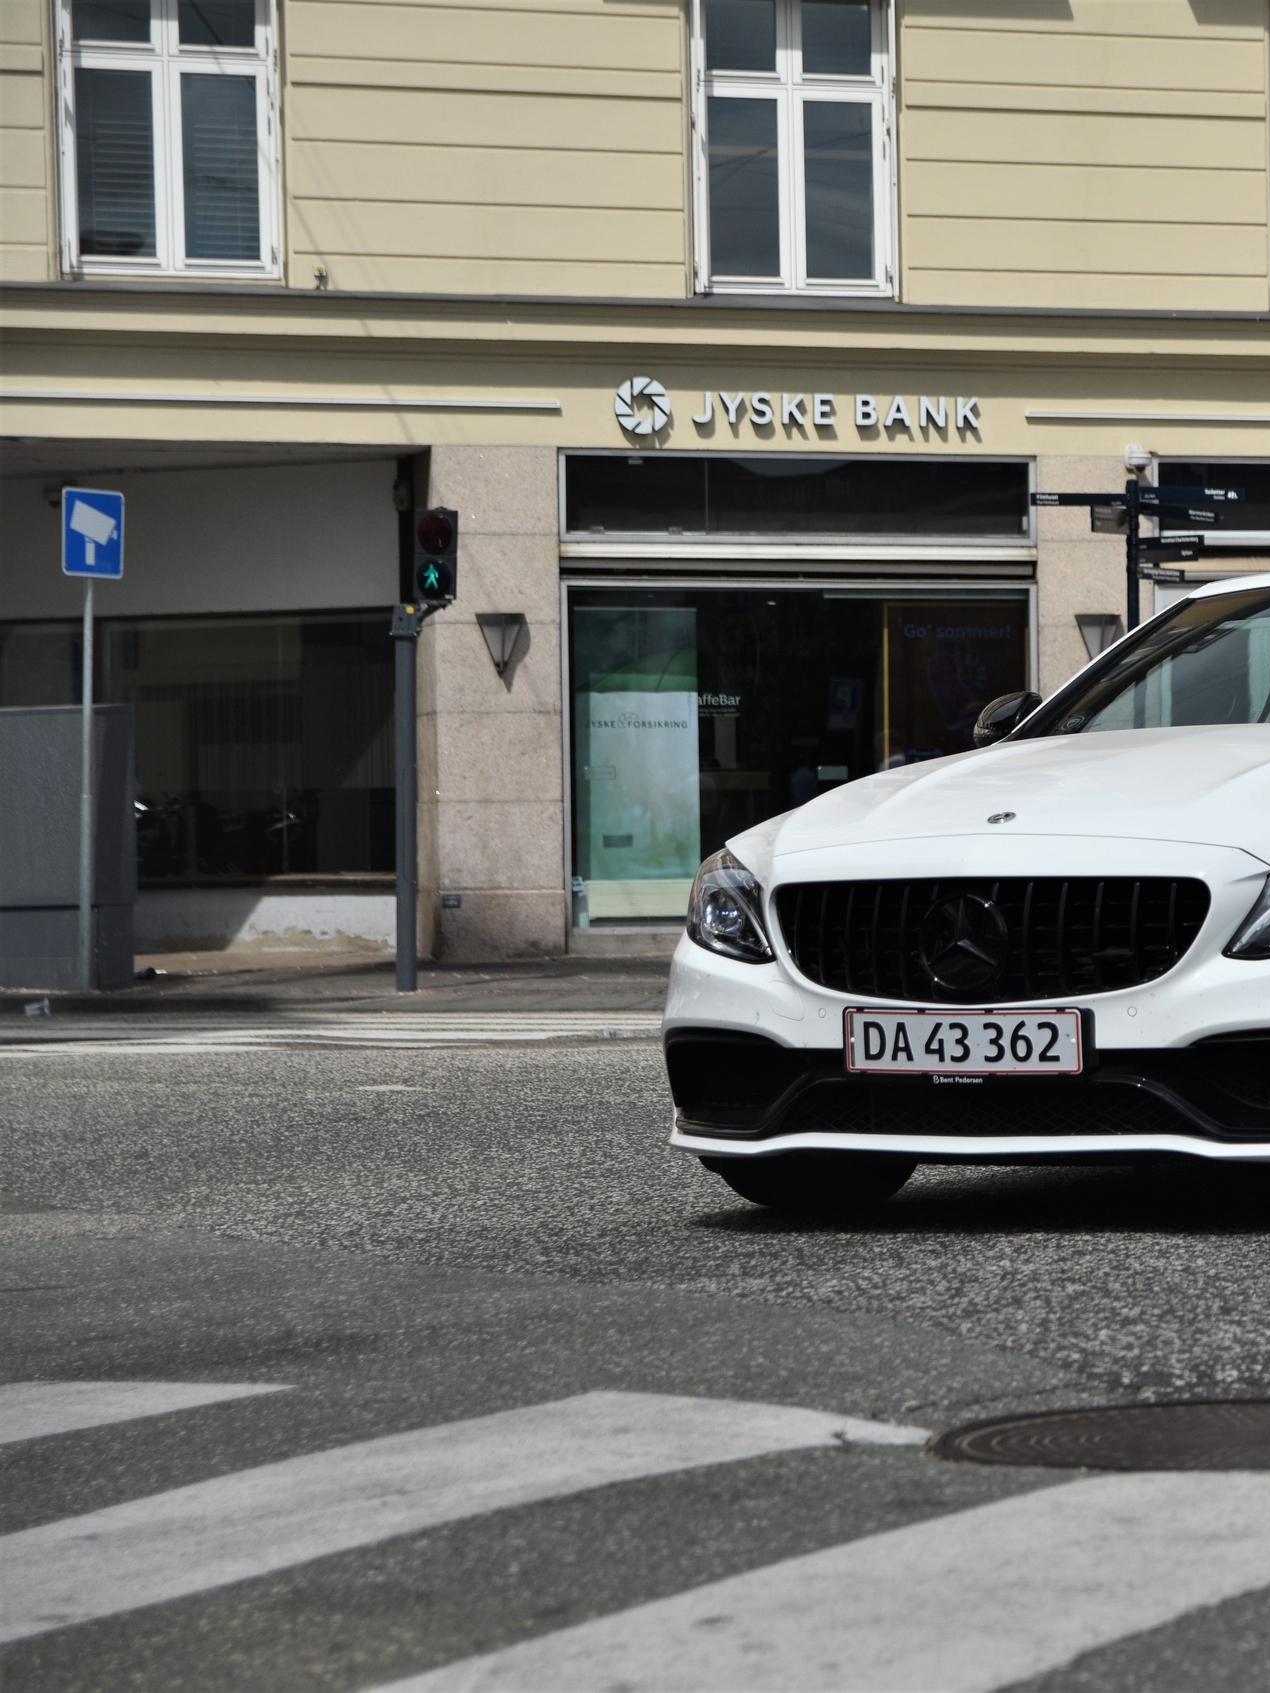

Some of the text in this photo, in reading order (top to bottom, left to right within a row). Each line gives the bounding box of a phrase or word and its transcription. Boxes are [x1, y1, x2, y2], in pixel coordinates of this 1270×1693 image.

[692, 391, 981, 430] JYSKE BANK
[936, 624, 1011, 639] sommer!
[586, 720, 688, 729] JYSKE FORSIKRING
[863, 1020, 1061, 1063] DA 43 362
[940, 1076, 984, 1084] Bent Pedersen
